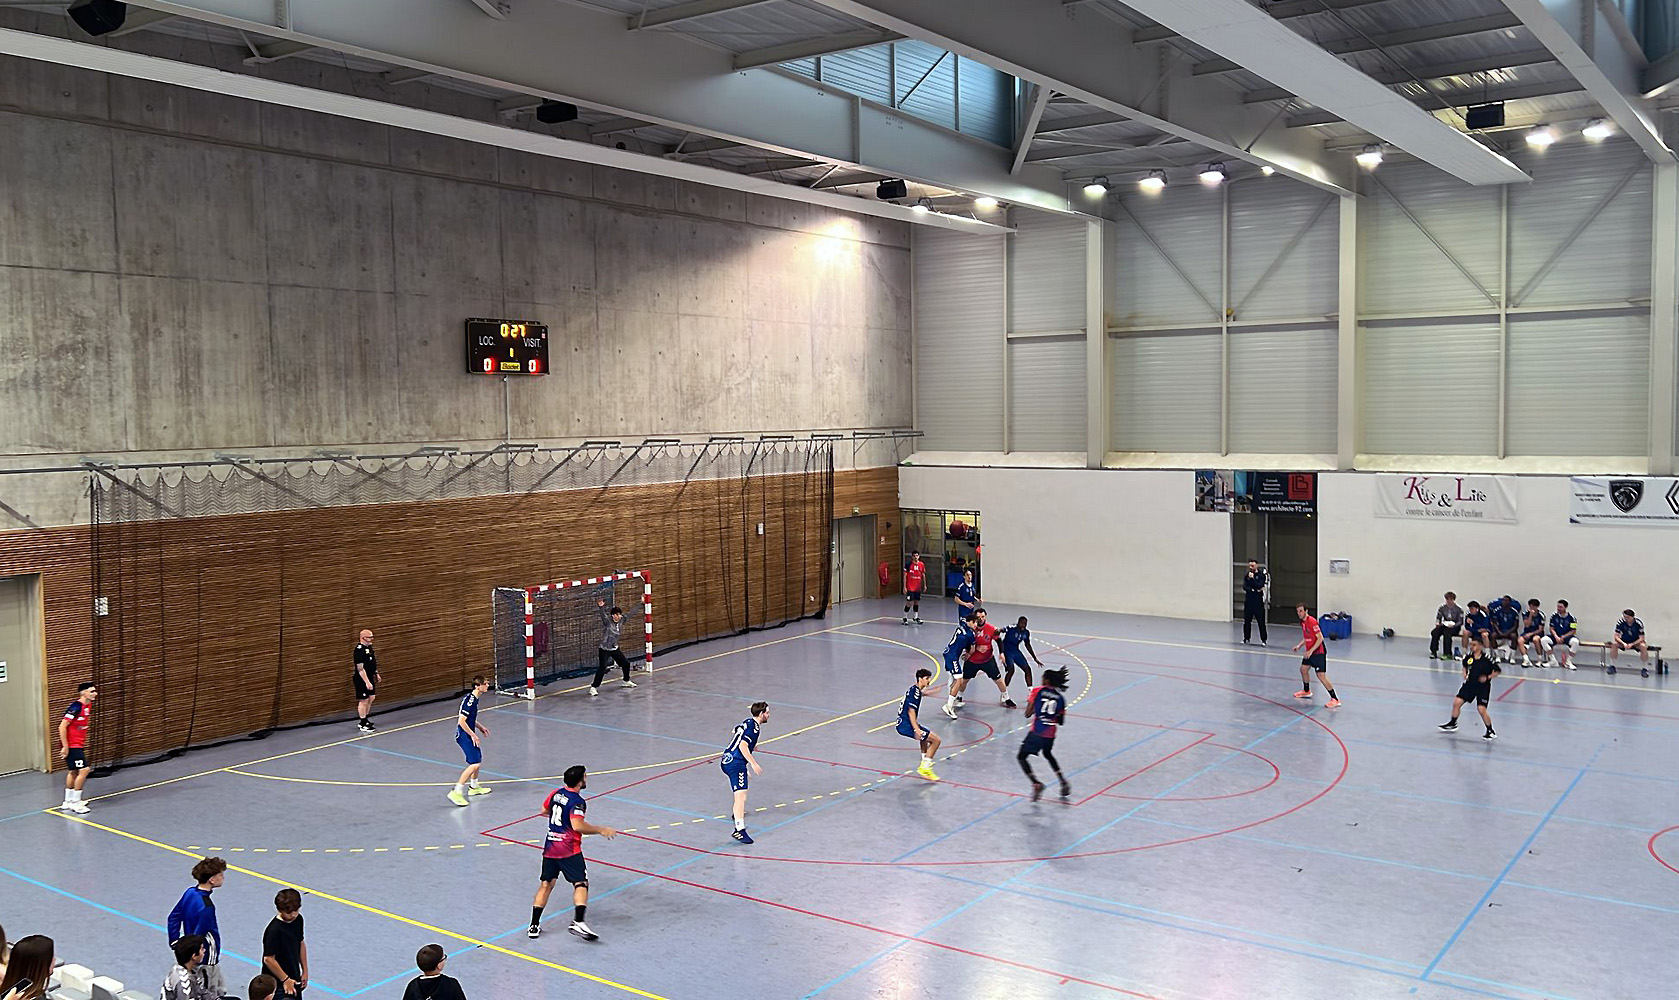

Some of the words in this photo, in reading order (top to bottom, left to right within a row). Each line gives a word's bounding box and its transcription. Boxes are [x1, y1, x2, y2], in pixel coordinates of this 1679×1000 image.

[522, 337, 542, 348] VISIT.
[1403, 476, 1436, 506] Kids
[1437, 492, 1452, 508] &
[1405, 508, 1425, 516] contre
[1425, 508, 1432, 517] le
[1452, 509, 1460, 517] de
